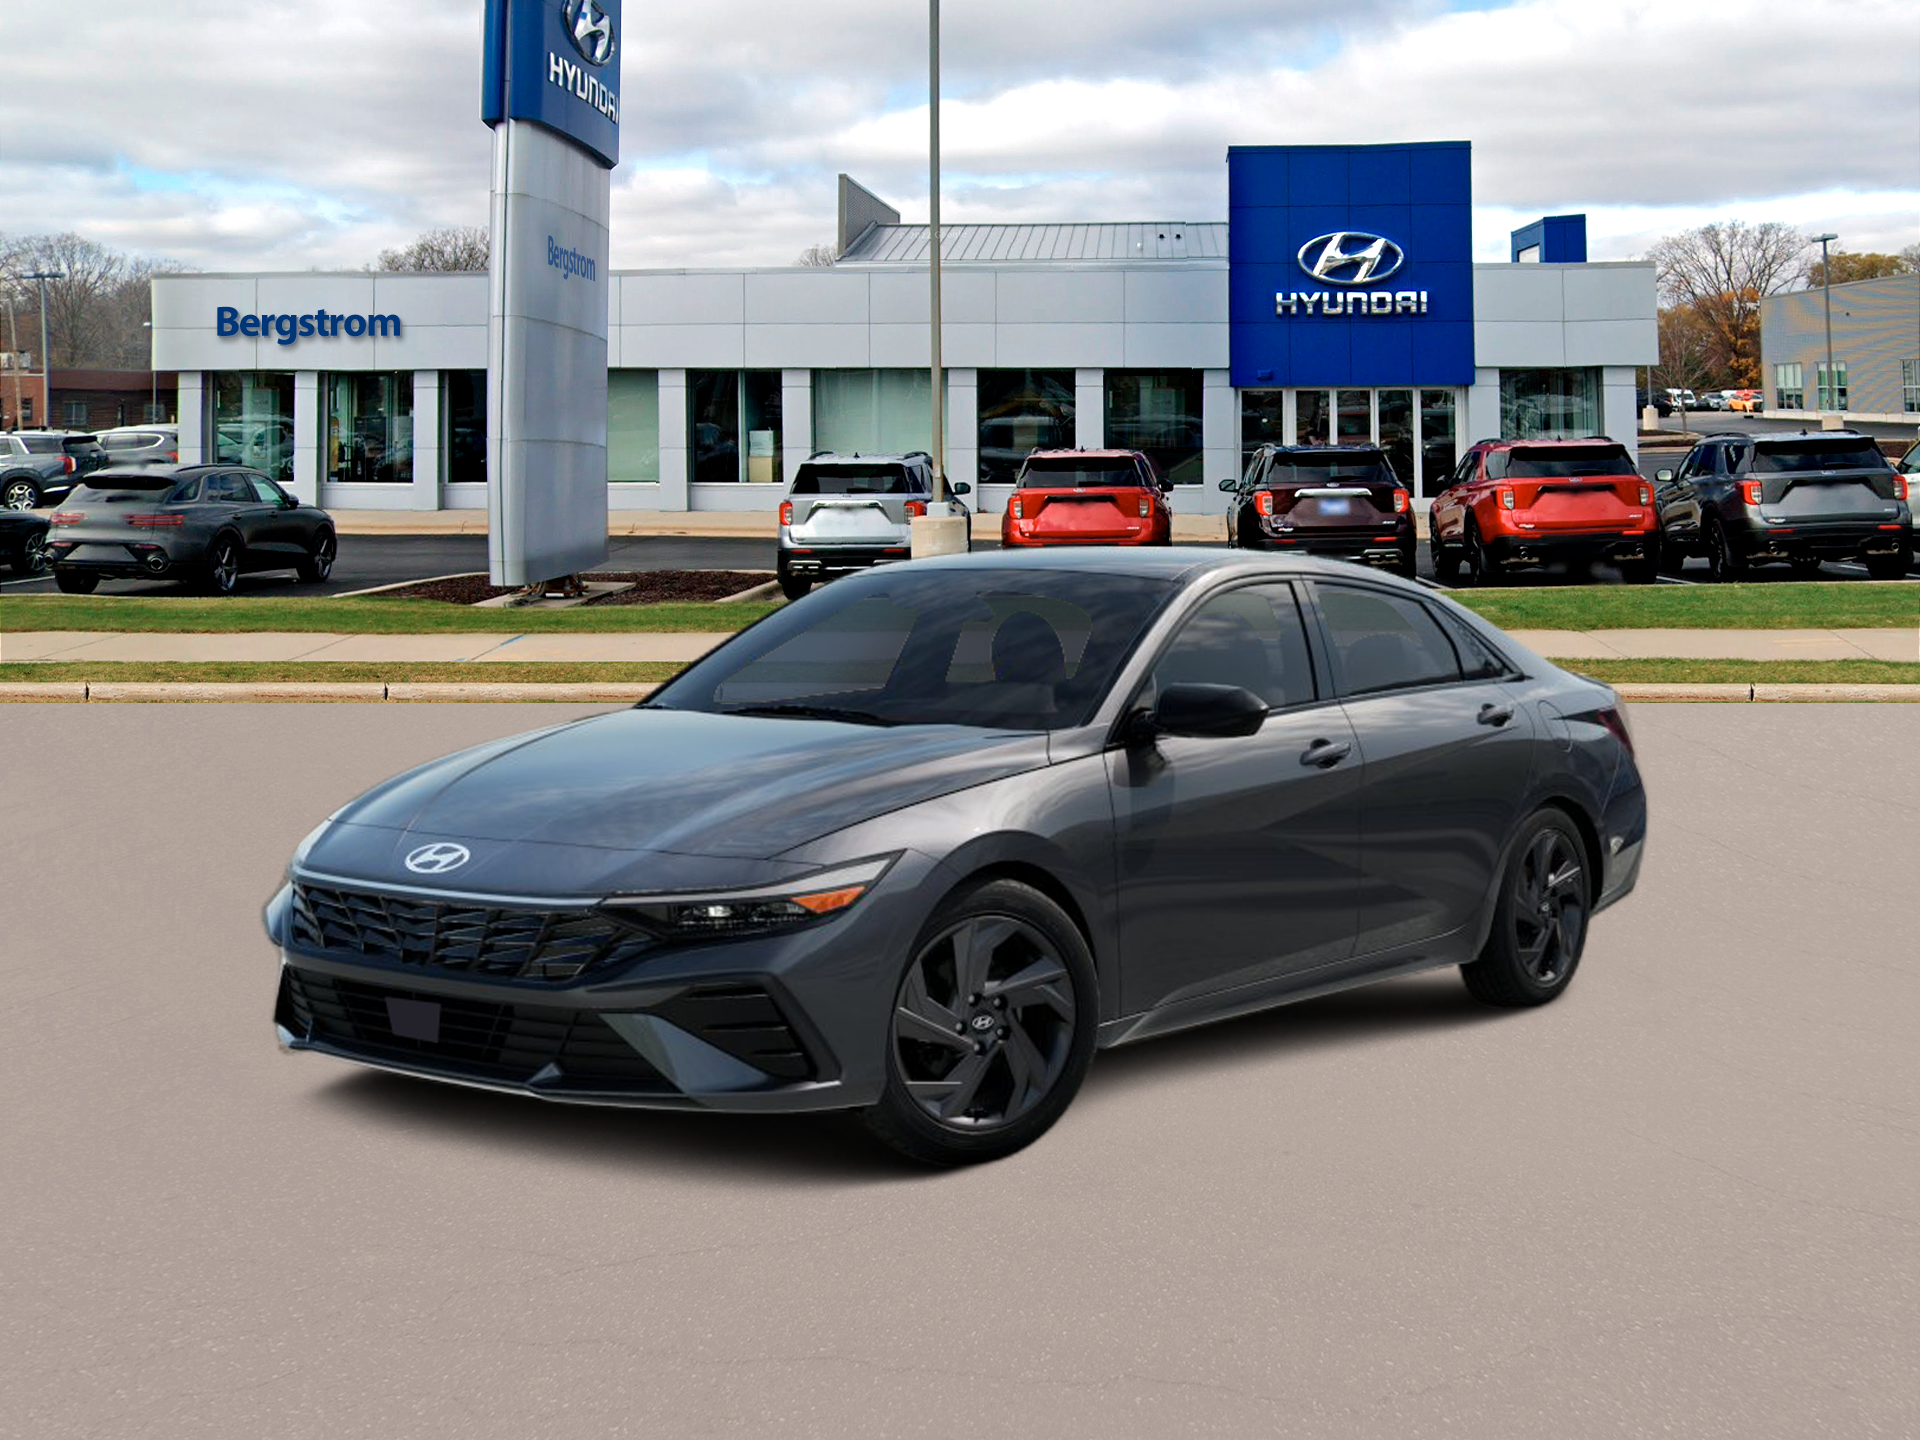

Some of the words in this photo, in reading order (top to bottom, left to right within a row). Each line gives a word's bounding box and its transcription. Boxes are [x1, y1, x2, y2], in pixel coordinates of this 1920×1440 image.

[549, 52, 619, 124] HYUNDAI
[547, 235, 596, 282] Bergstrom
[1275, 291, 1428, 315] HYUNDAI
[216, 306, 401, 346] Bergstrom
